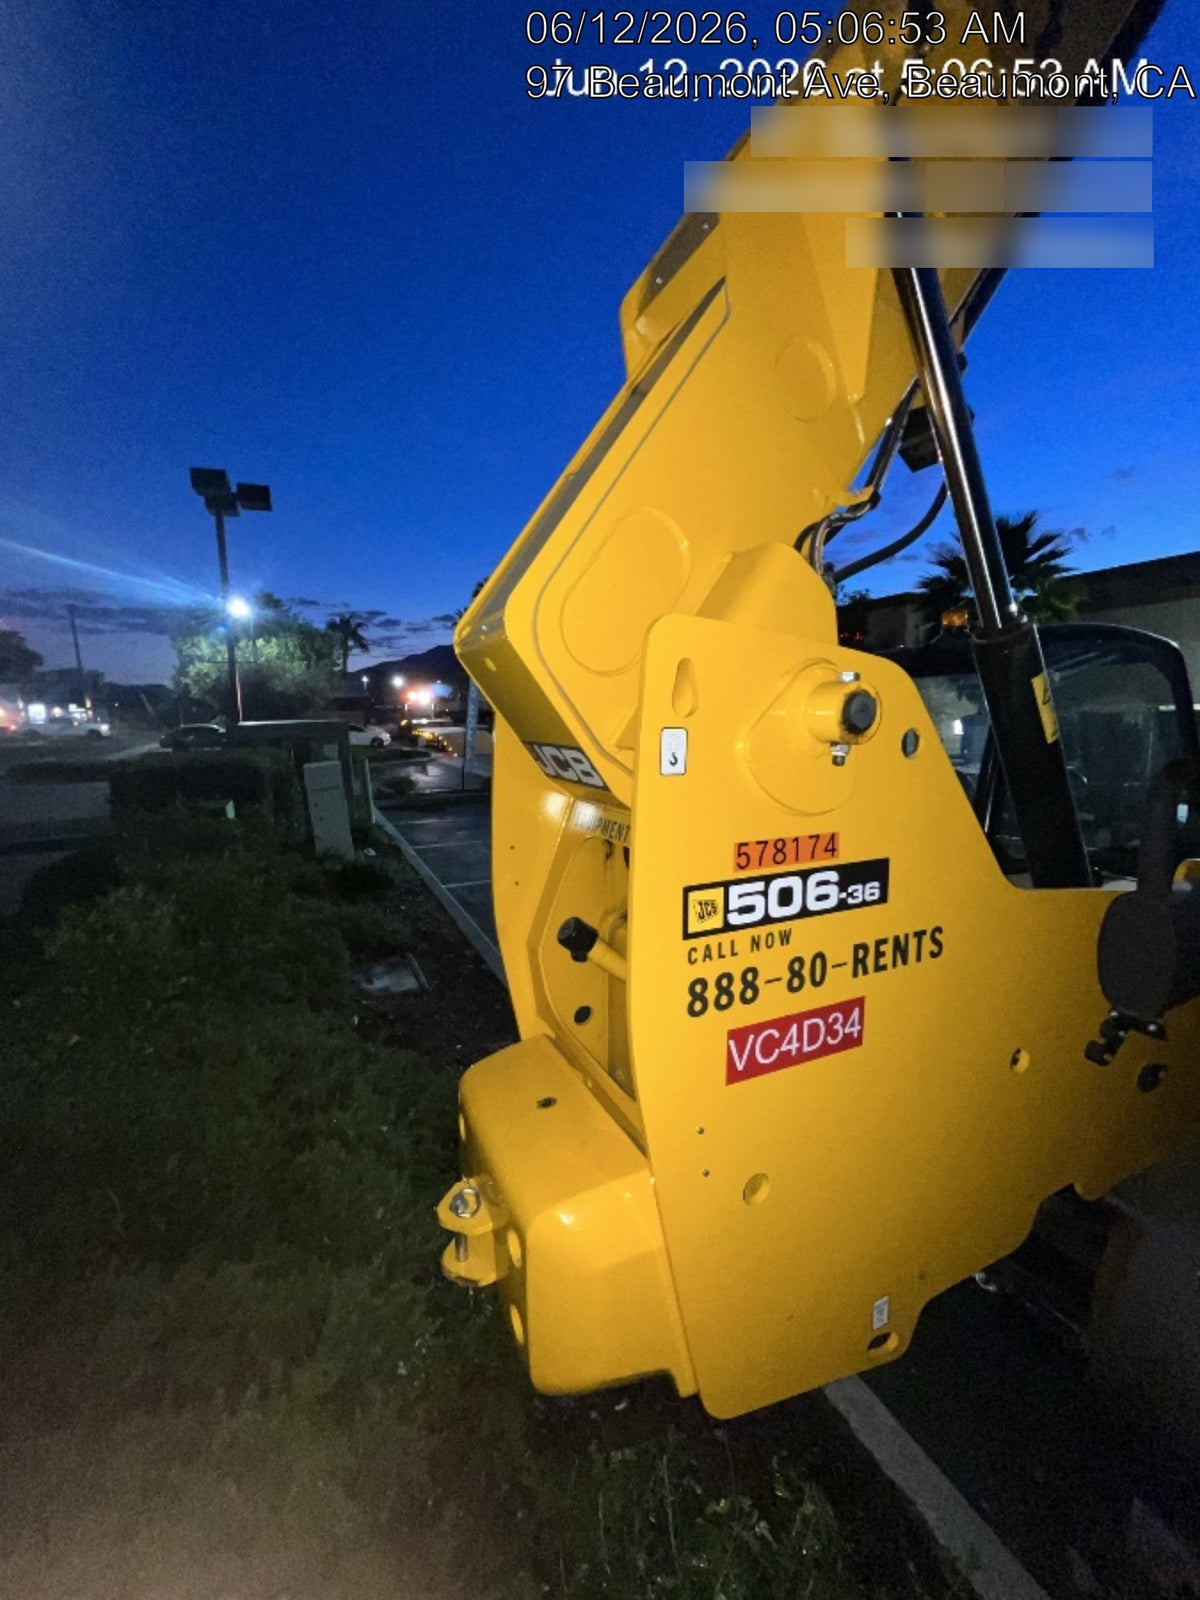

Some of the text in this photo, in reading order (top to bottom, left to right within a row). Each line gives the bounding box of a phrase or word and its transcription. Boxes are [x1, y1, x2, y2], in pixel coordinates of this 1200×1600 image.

[533, 744, 604, 787] JCB
[736, 833, 838, 869] 578174
[727, 870, 881, 925] 506-36
[687, 928, 792, 965] CALL NOW
[729, 1007, 861, 1072] VC4D34
